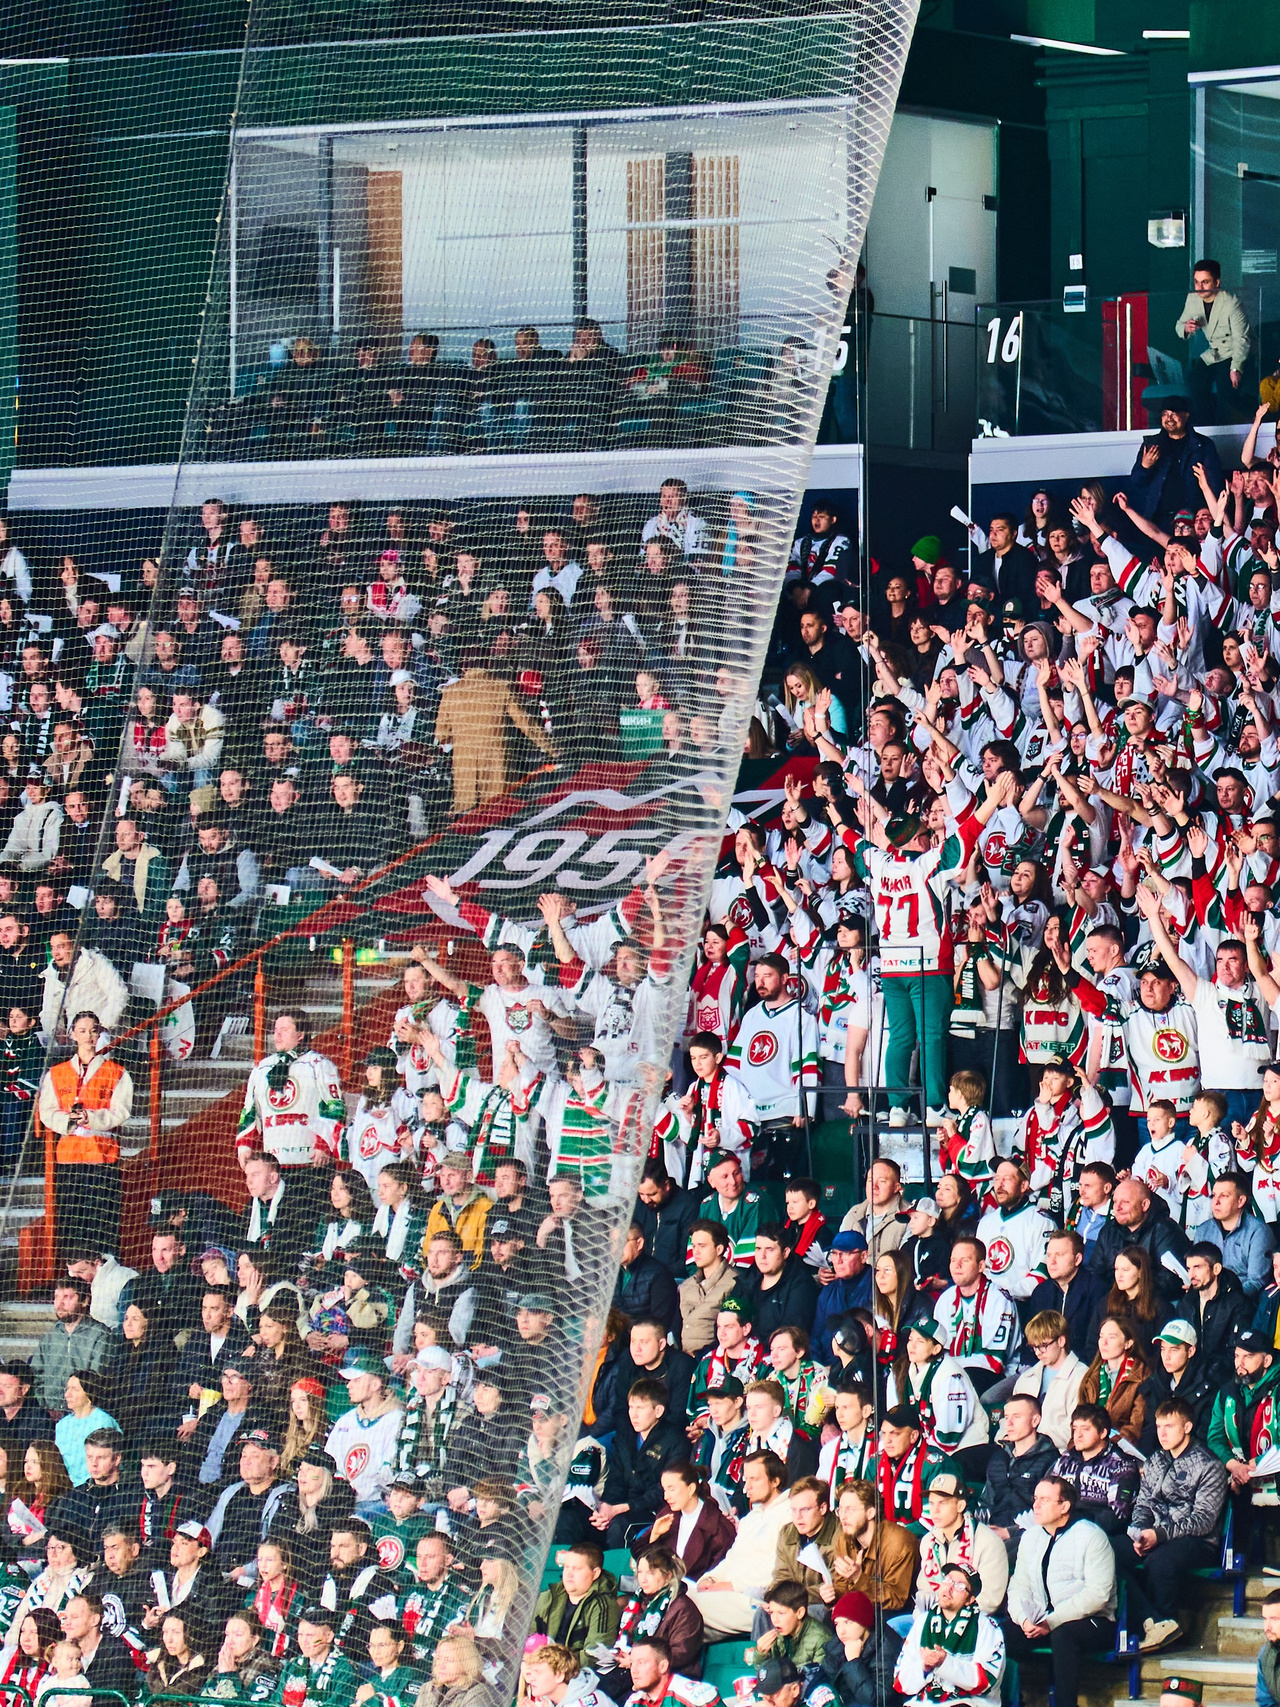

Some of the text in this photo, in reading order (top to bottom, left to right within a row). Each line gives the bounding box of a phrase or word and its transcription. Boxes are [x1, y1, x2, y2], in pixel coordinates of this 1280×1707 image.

[987, 317, 1022, 363] 16
[877, 893, 919, 941] 77
[1026, 1041, 1076, 1053] ATNEFT
